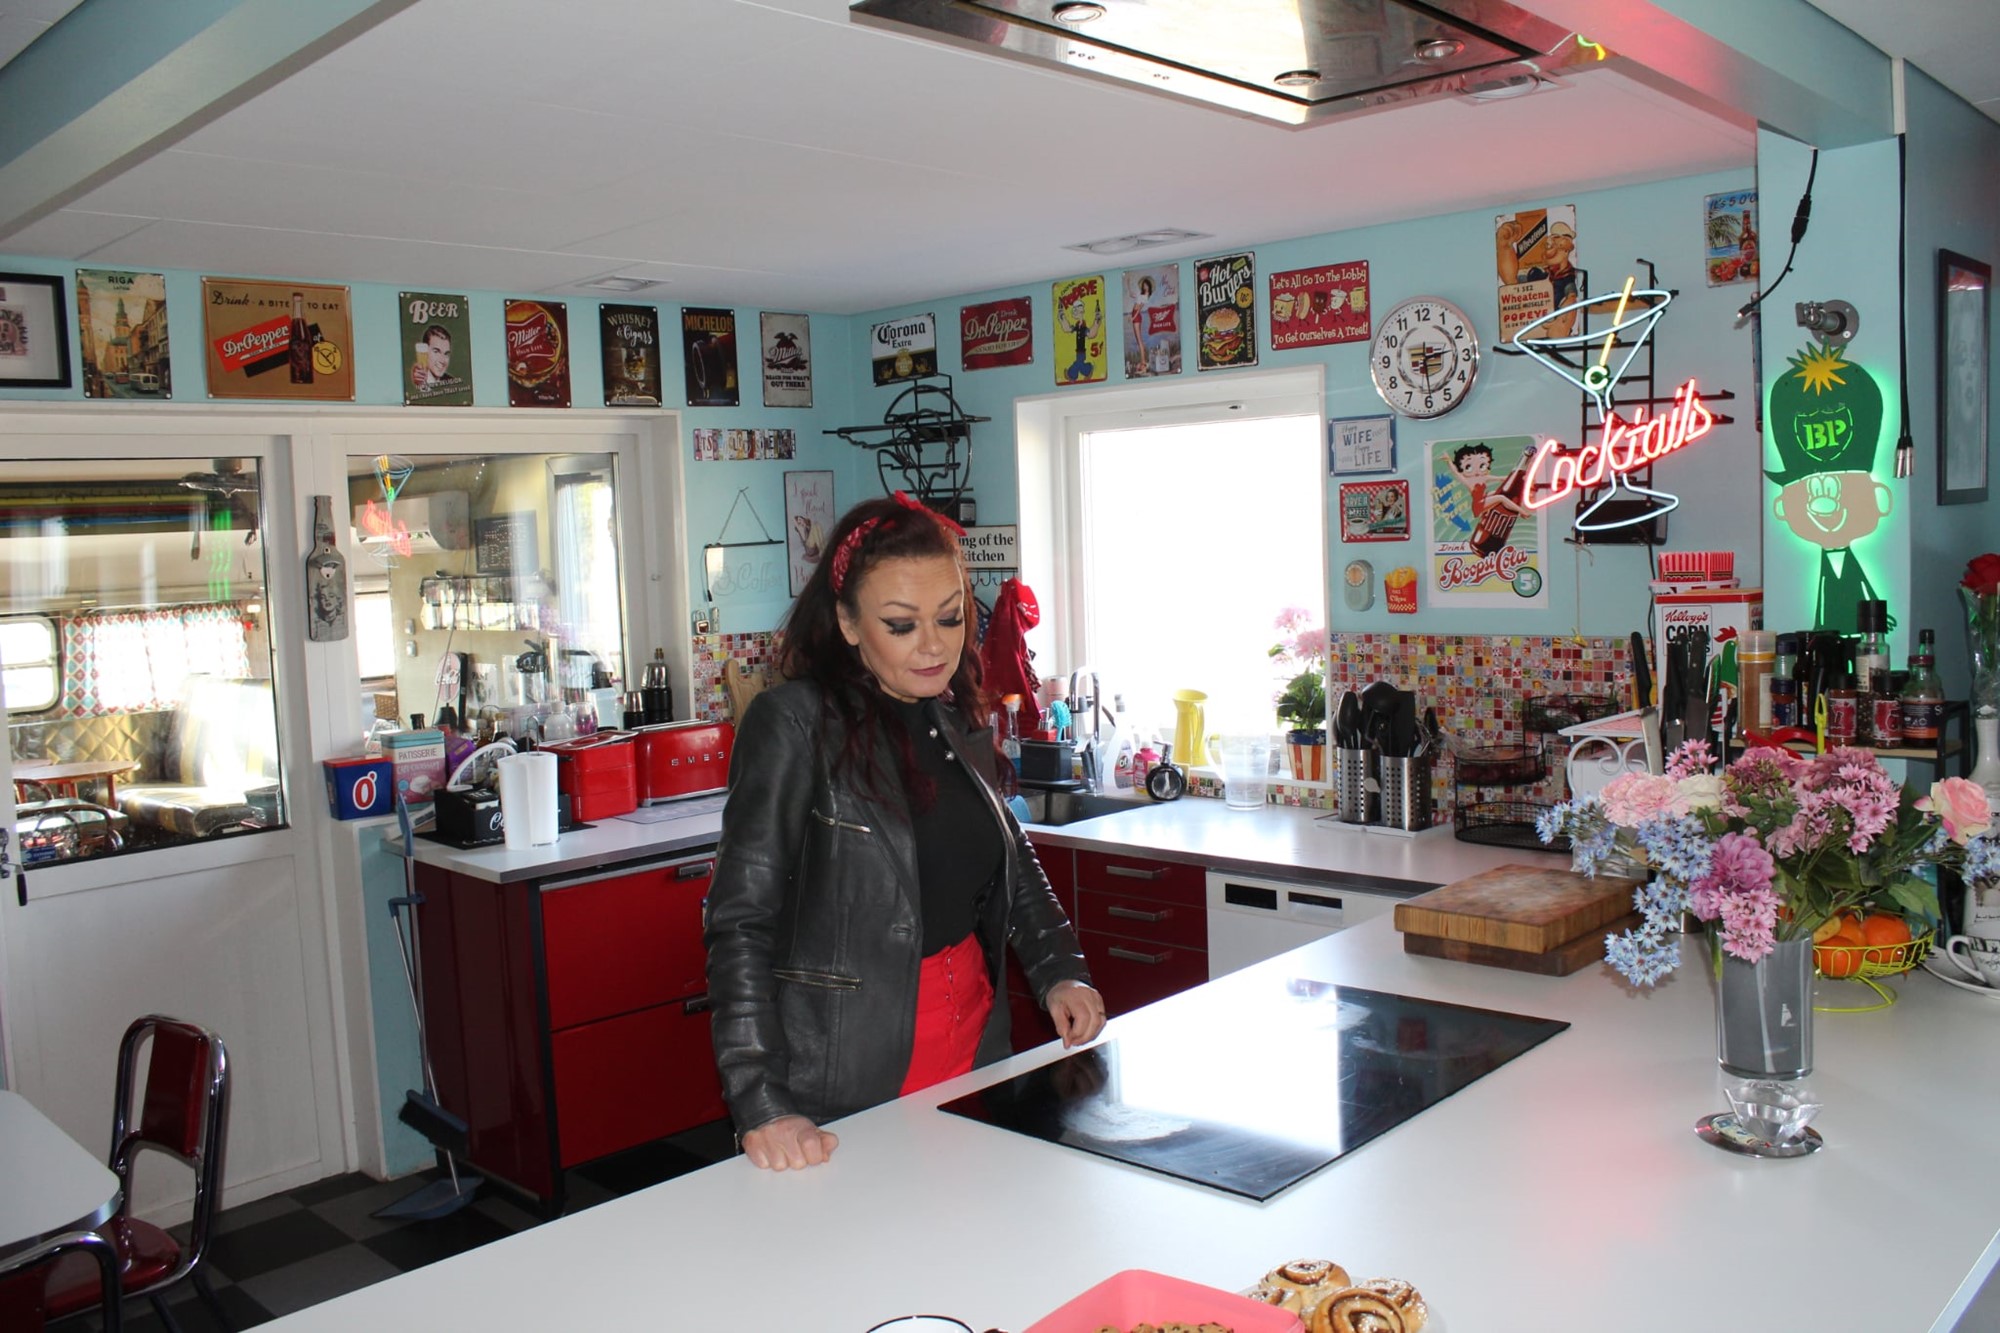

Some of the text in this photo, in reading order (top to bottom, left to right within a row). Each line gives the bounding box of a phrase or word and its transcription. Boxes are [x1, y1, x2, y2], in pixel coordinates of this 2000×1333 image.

[1729, 197, 1736, 207] 5
[108, 276, 134, 285] RIGA
[1209, 263, 1233, 287] Hot
[1273, 267, 1367, 289] Let's All Go To The Lobby
[1200, 265, 1251, 307] Burgers
[212, 290, 250, 306] Drink
[322, 303, 340, 311] EAT
[1061, 279, 1098, 310] POPEYE
[1502, 291, 1550, 304] Wheatena
[607, 313, 653, 329] WHISKEY
[1415, 308, 1431, 322] 12
[1440, 312, 1446, 325] 1
[1504, 309, 1548, 323] POPEYE
[685, 315, 734, 332] MICHELOB
[1397, 318, 1408, 331] 11
[508, 327, 541, 348] Miller
[877, 322, 926, 346] Corona
[1274, 335, 1284, 345] To
[1285, 330, 1299, 344] Get
[1300, 327, 1336, 341] Ourselves
[1337, 328, 1345, 339] A
[1455, 326, 1464, 339] 2
[892, 340, 912, 349] Extra
[1385, 335, 1398, 349] 10
[1382, 356, 1391, 369] 9
[1462, 349, 1472, 362] 3
[1390, 376, 1398, 389] 8
[1458, 370, 1466, 383] 4
[1405, 392, 1413, 404] 7
[1444, 389, 1452, 401] 5
[1425, 396, 1433, 409] 6
[1343, 429, 1372, 446] WIFE
[1803, 419, 1847, 450] BP
[1523, 378, 1713, 510] Cocktails
[1355, 450, 1382, 467] LIFE
[959, 533, 1014, 549] ing of the
[1439, 541, 1466, 552] Drink
[1496, 546, 1528, 581] Cola
[1665, 609, 1709, 625] Kellogg's
[399, 748, 437, 761] PATISSERIE
[672, 751, 724, 766] SMEG
